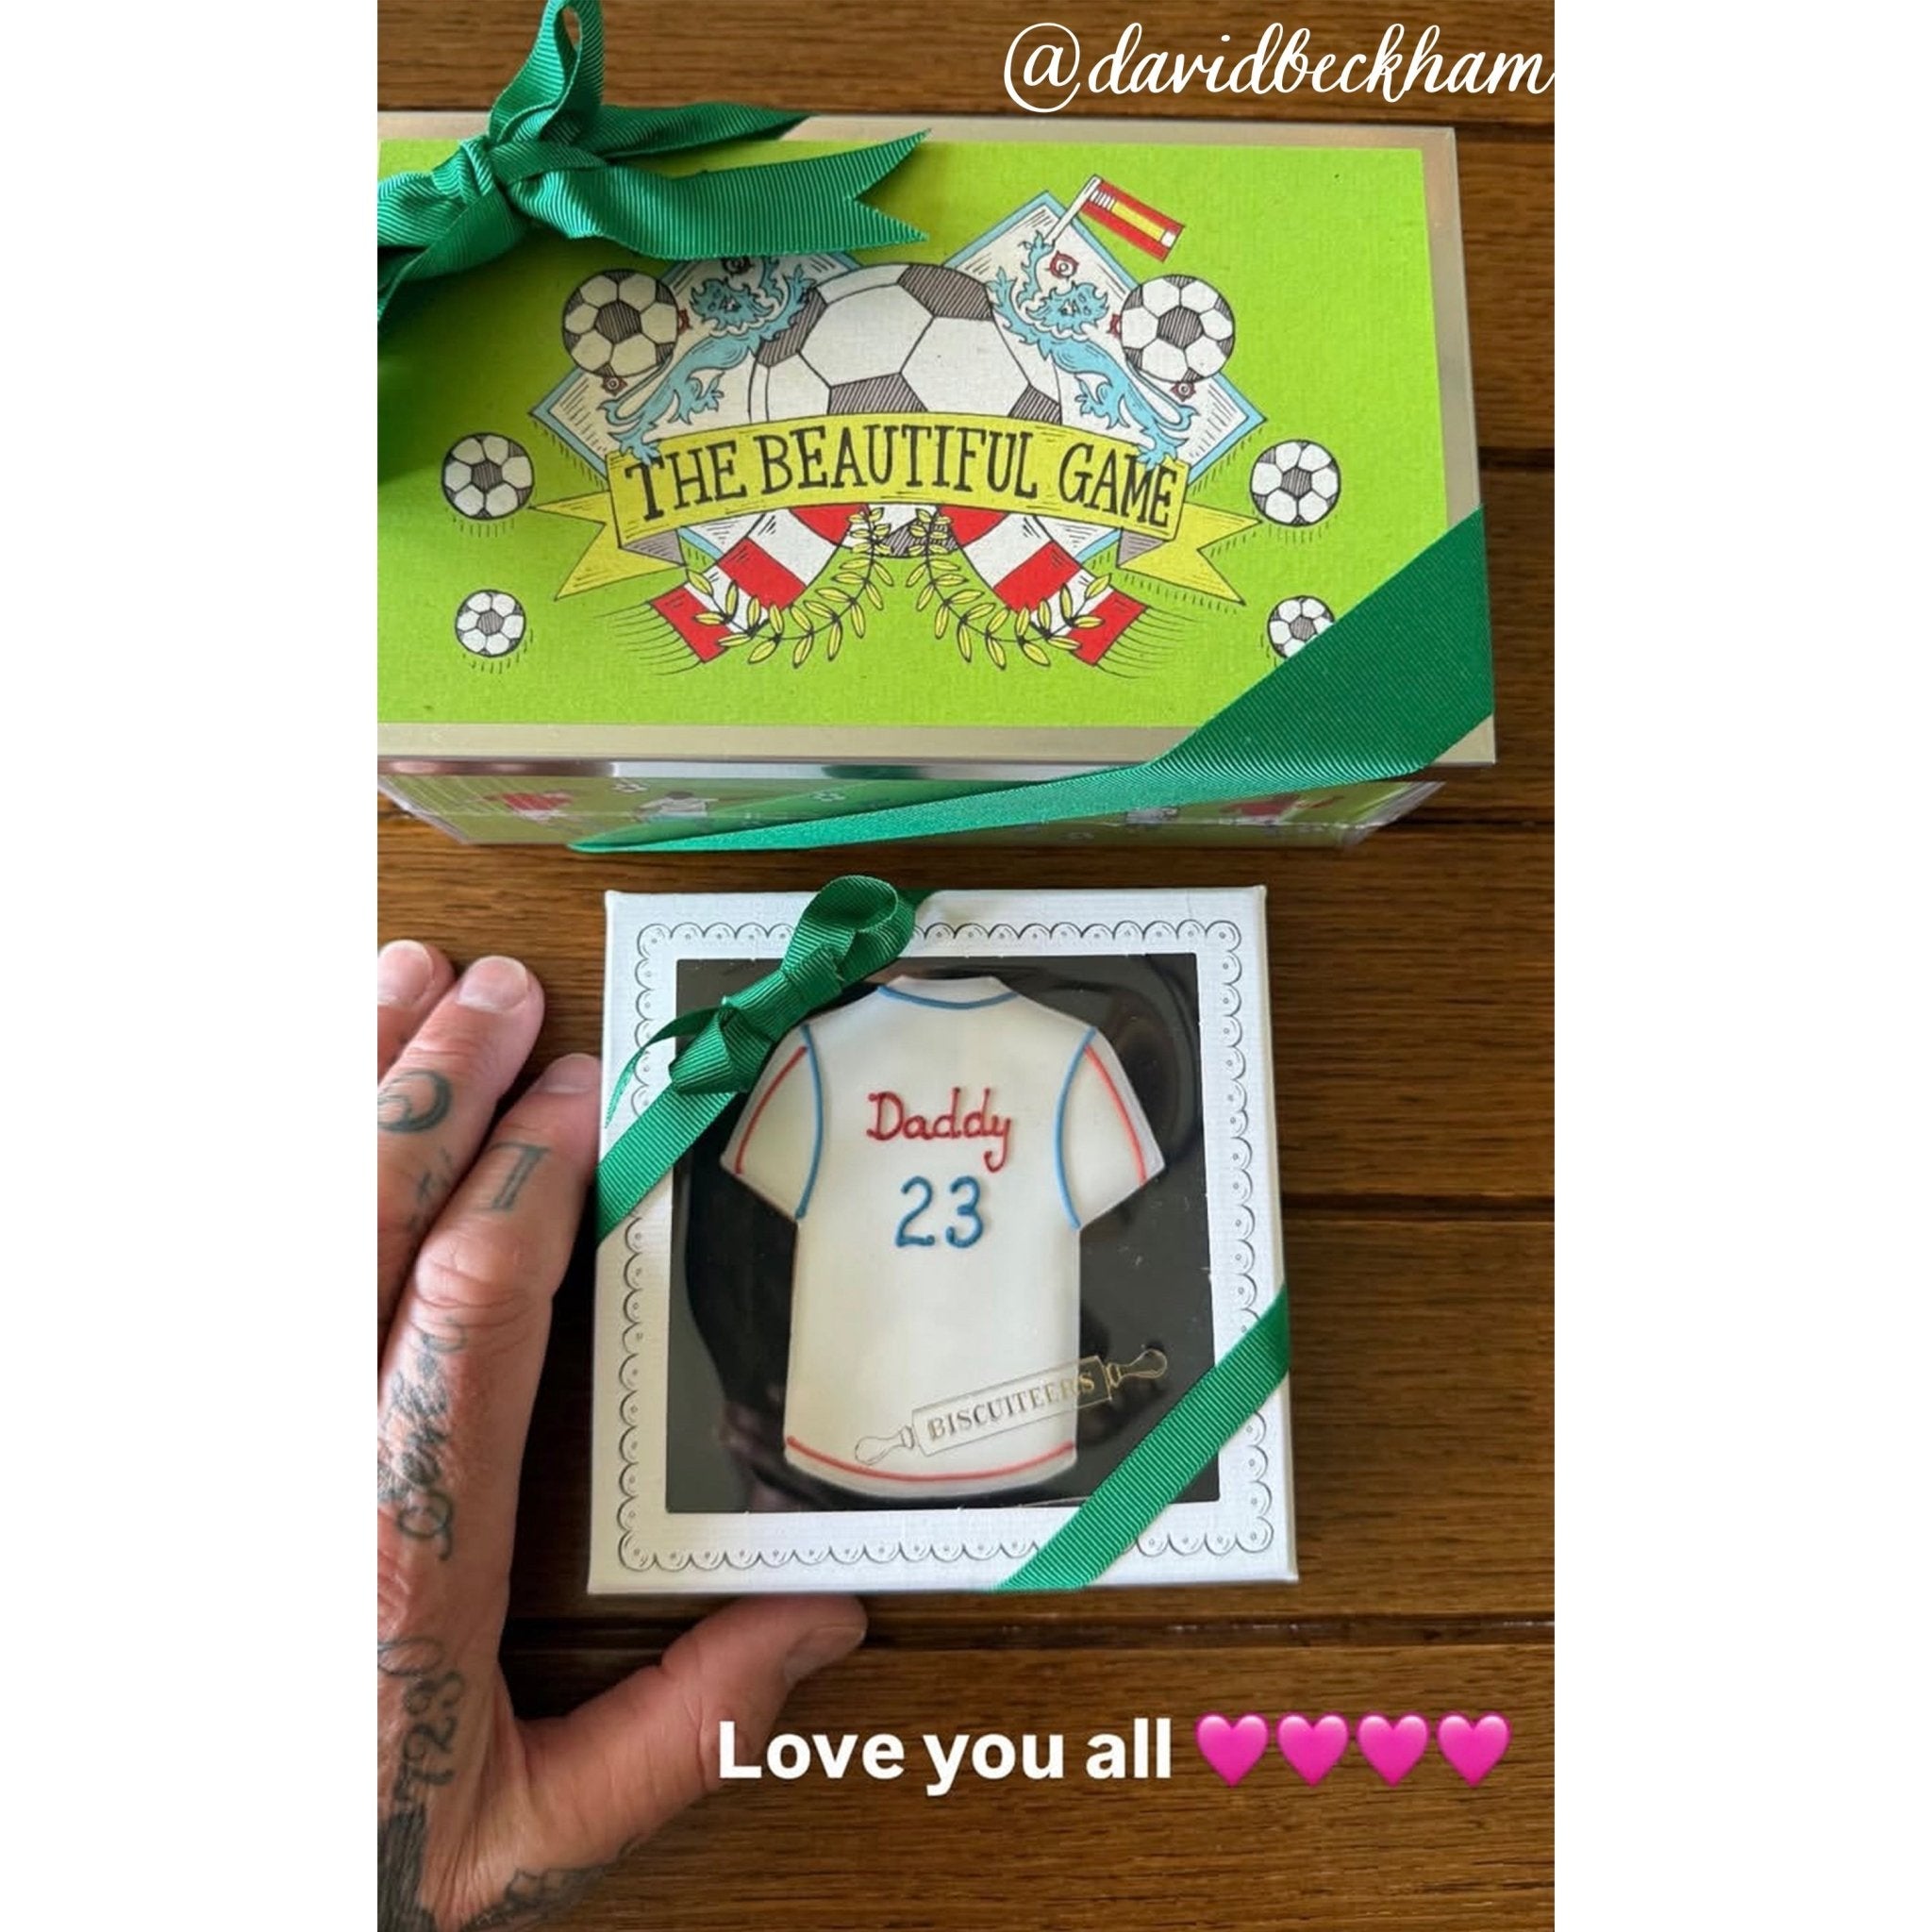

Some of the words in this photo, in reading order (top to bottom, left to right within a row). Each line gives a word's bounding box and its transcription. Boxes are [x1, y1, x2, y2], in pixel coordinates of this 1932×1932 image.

[624, 440, 748, 522] THE
[752, 423, 1039, 500] BEAUTIFUL
[1058, 441, 1177, 527] GAME
[866, 1087, 1011, 1173] Daddy
[894, 1175, 984, 1248] 23
[926, 1371, 1096, 1441] BISCUITEERS
